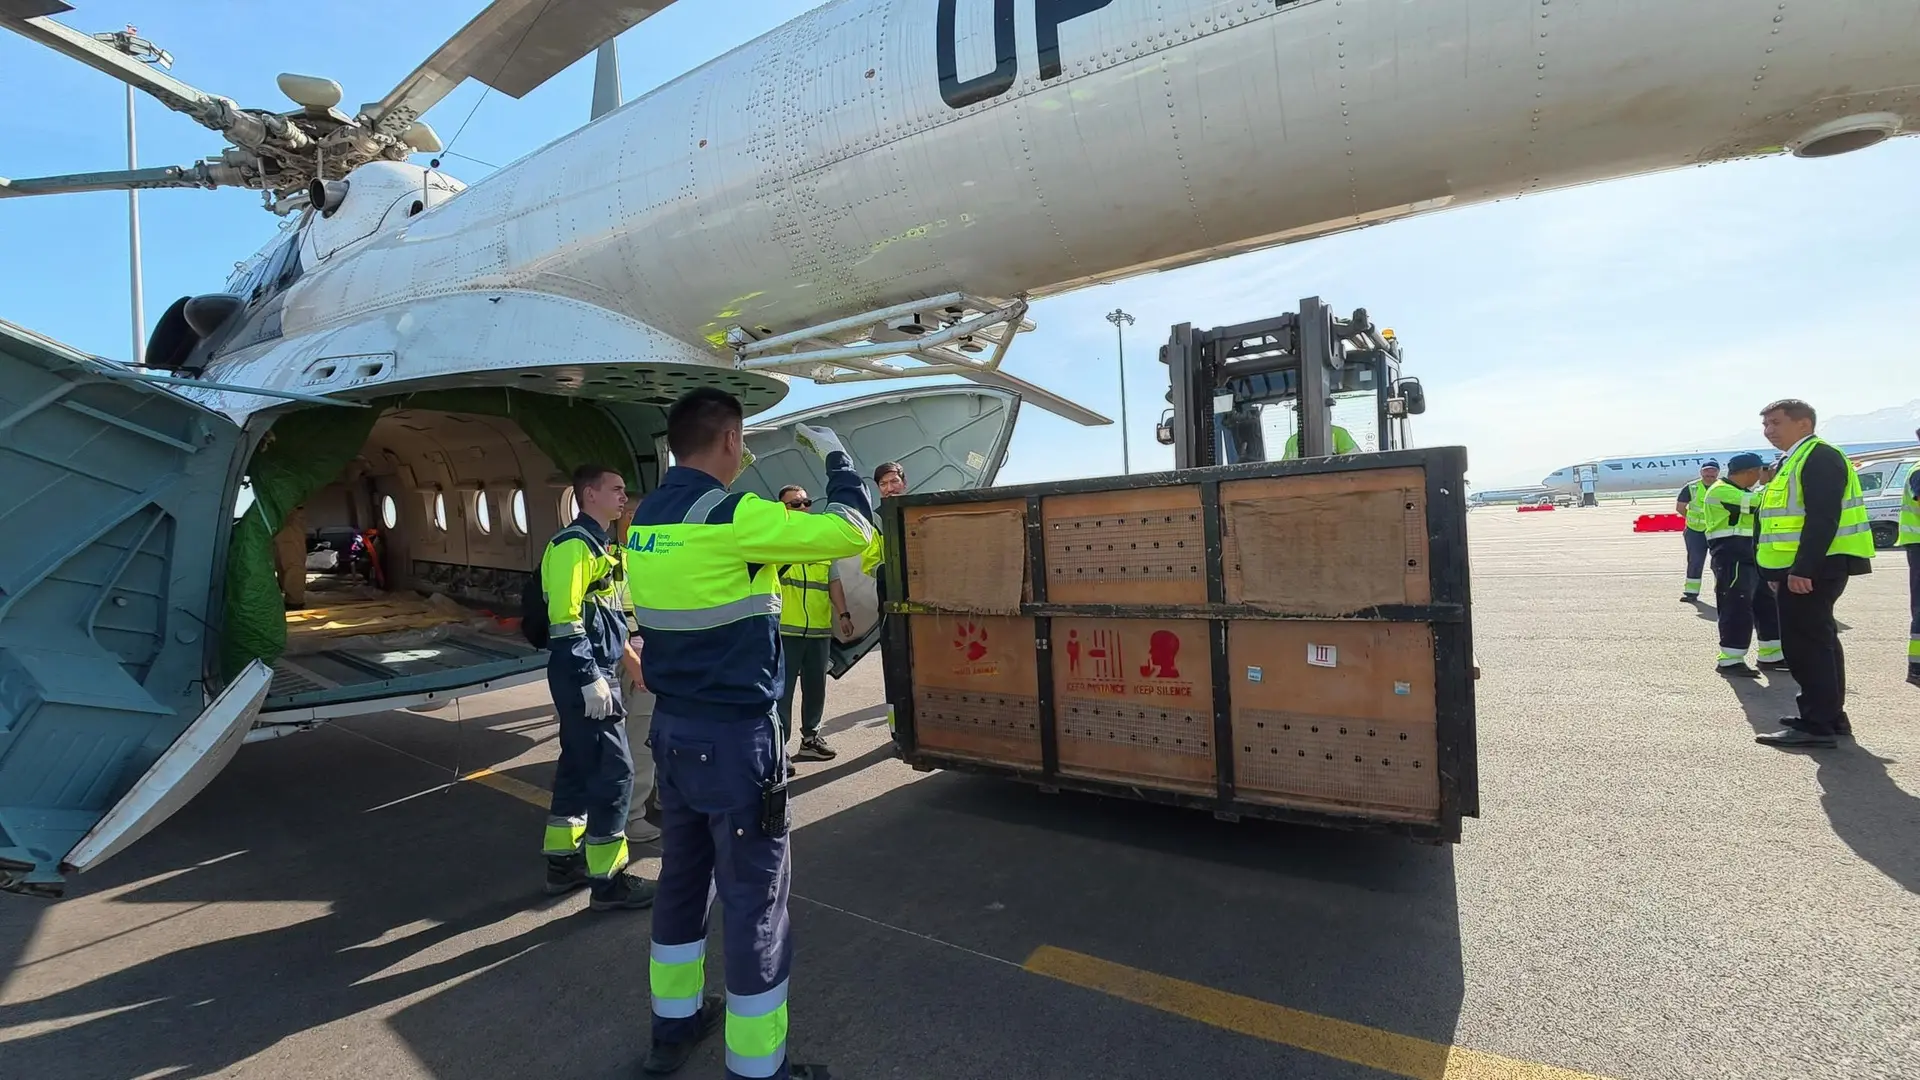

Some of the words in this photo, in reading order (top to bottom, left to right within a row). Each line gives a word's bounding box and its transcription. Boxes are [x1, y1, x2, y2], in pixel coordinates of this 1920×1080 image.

[628, 531, 656, 552] ALA
[1134, 685, 1154, 695] KEEP
[1156, 685, 1192, 697] SILENCE
